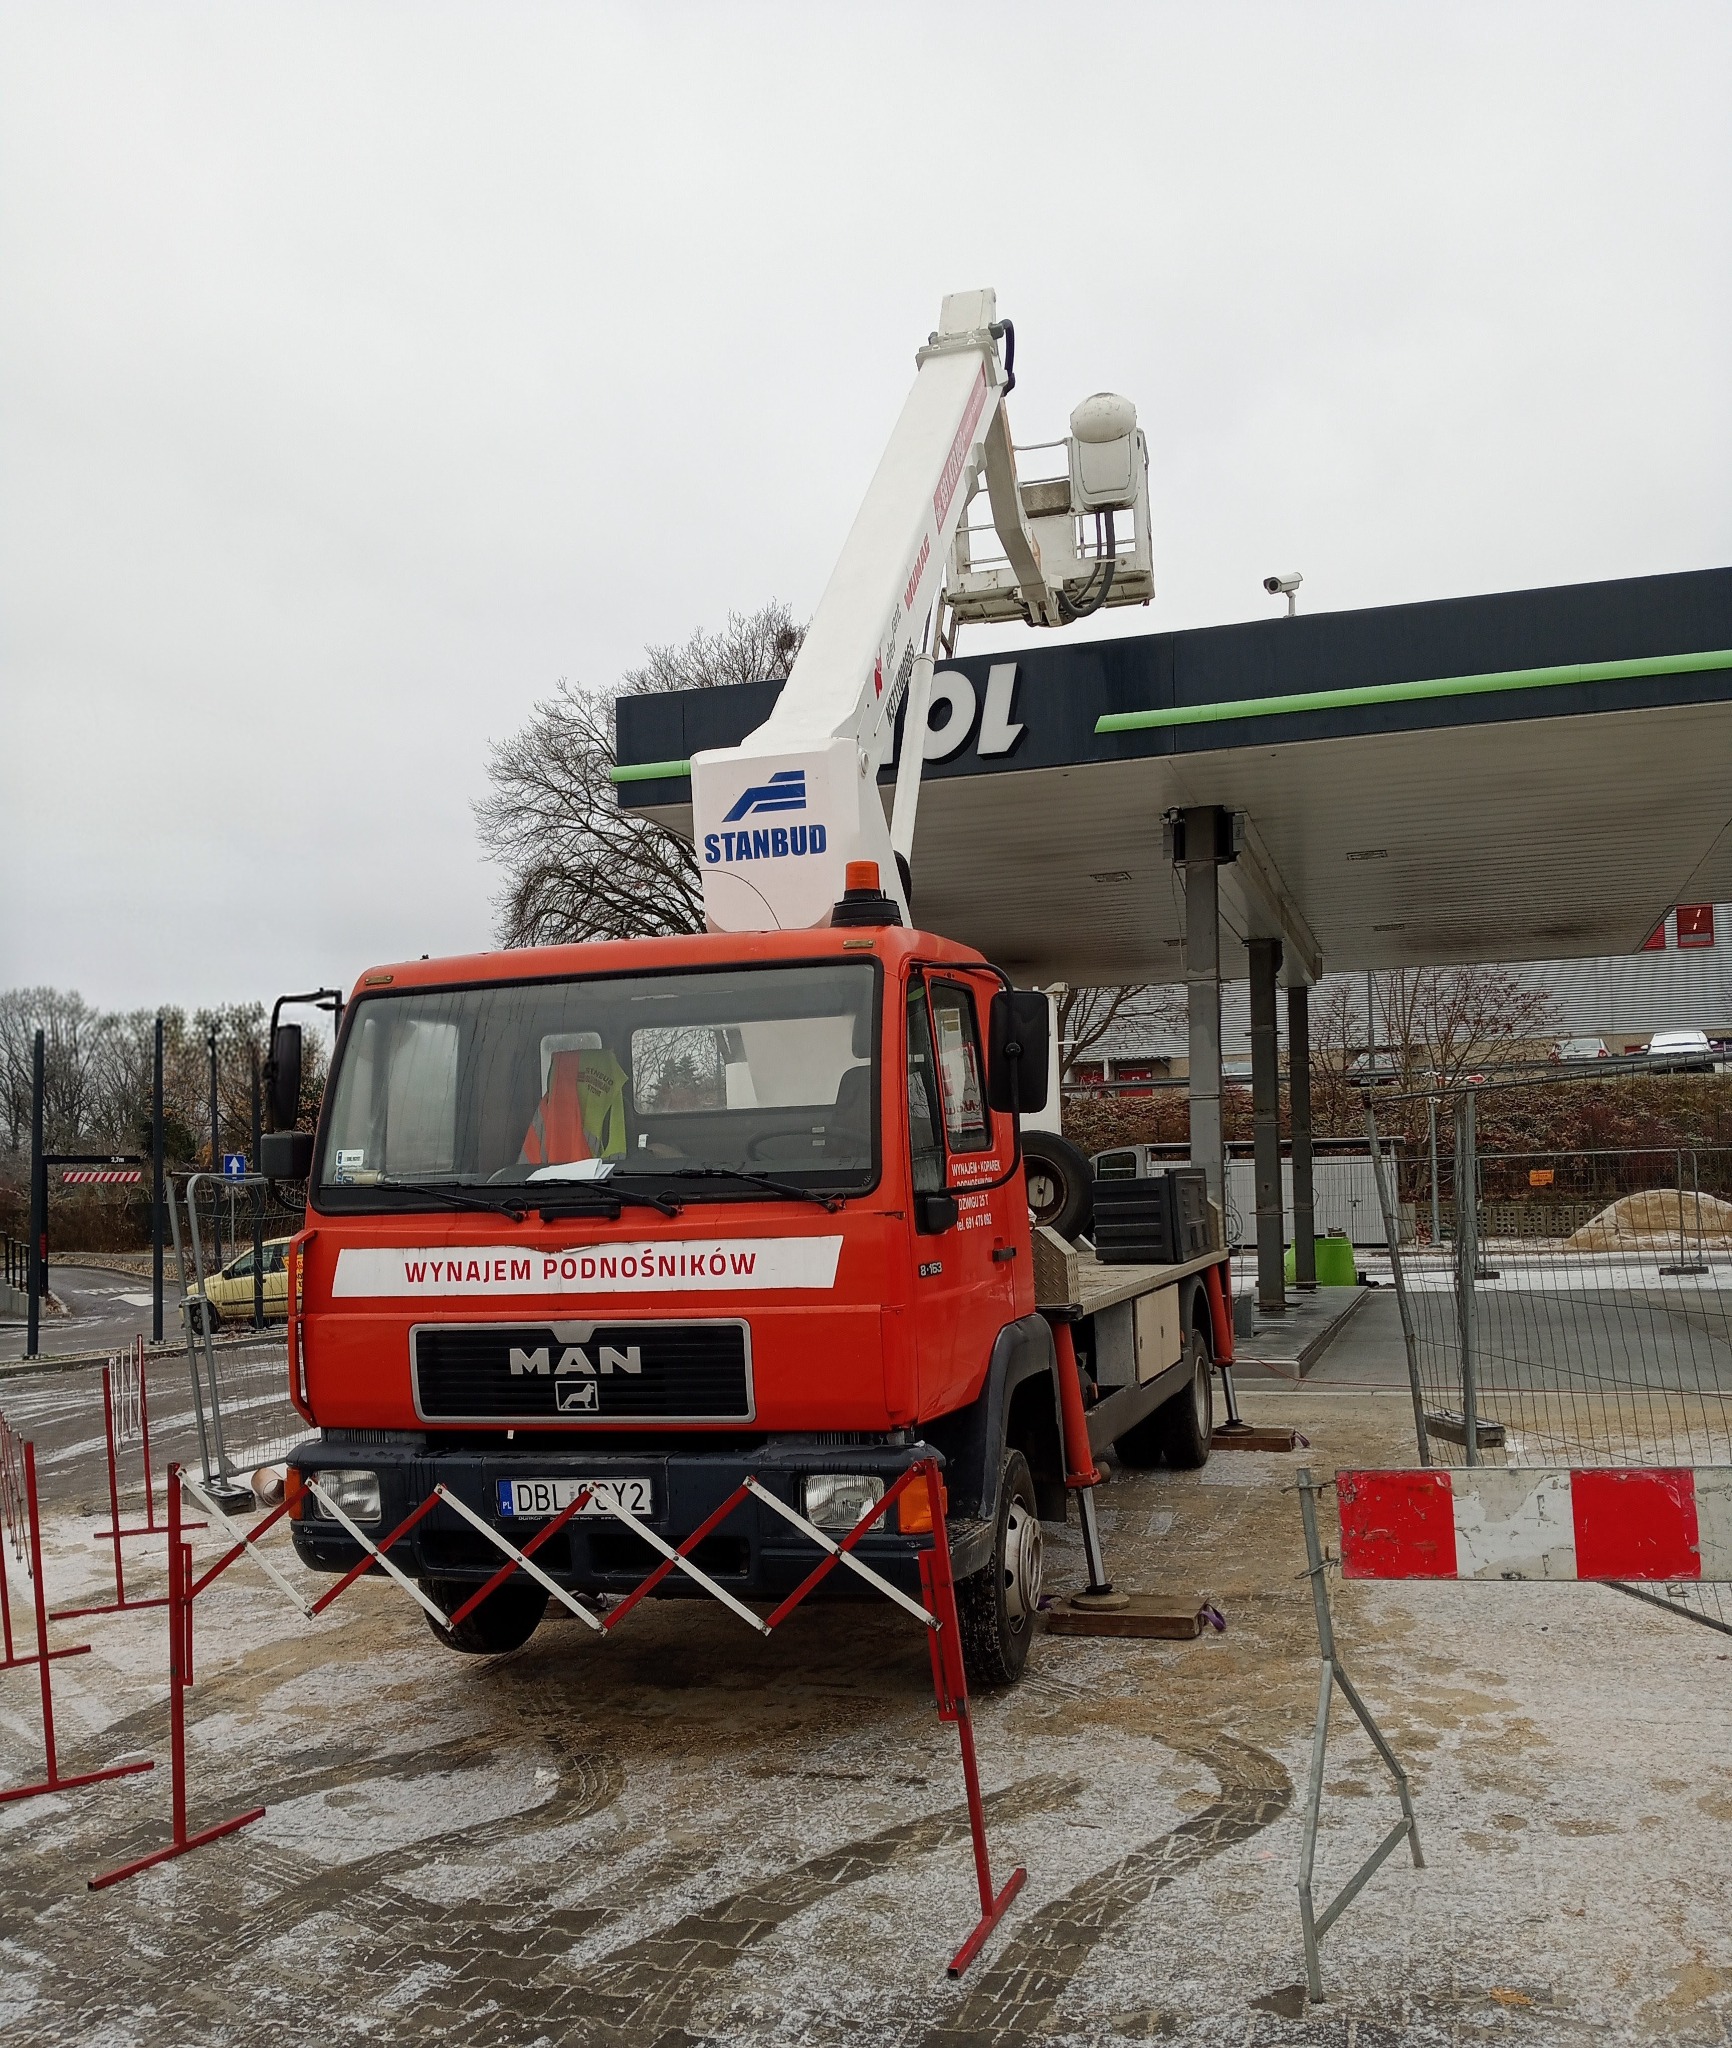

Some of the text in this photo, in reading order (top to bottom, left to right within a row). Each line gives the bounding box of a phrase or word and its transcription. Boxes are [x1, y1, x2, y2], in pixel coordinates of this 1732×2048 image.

[880, 662, 1024, 764] OL
[704, 824, 827, 864] STANBUD
[951, 1159, 1002, 1176] WYNAJEM KOPAREK
[404, 1249, 758, 1284] WYNAJEM PODNOŚNIKÓW
[509, 1346, 642, 1375] MAN
[502, 1501, 512, 1510] PL
[516, 1483, 564, 1512] DBL
